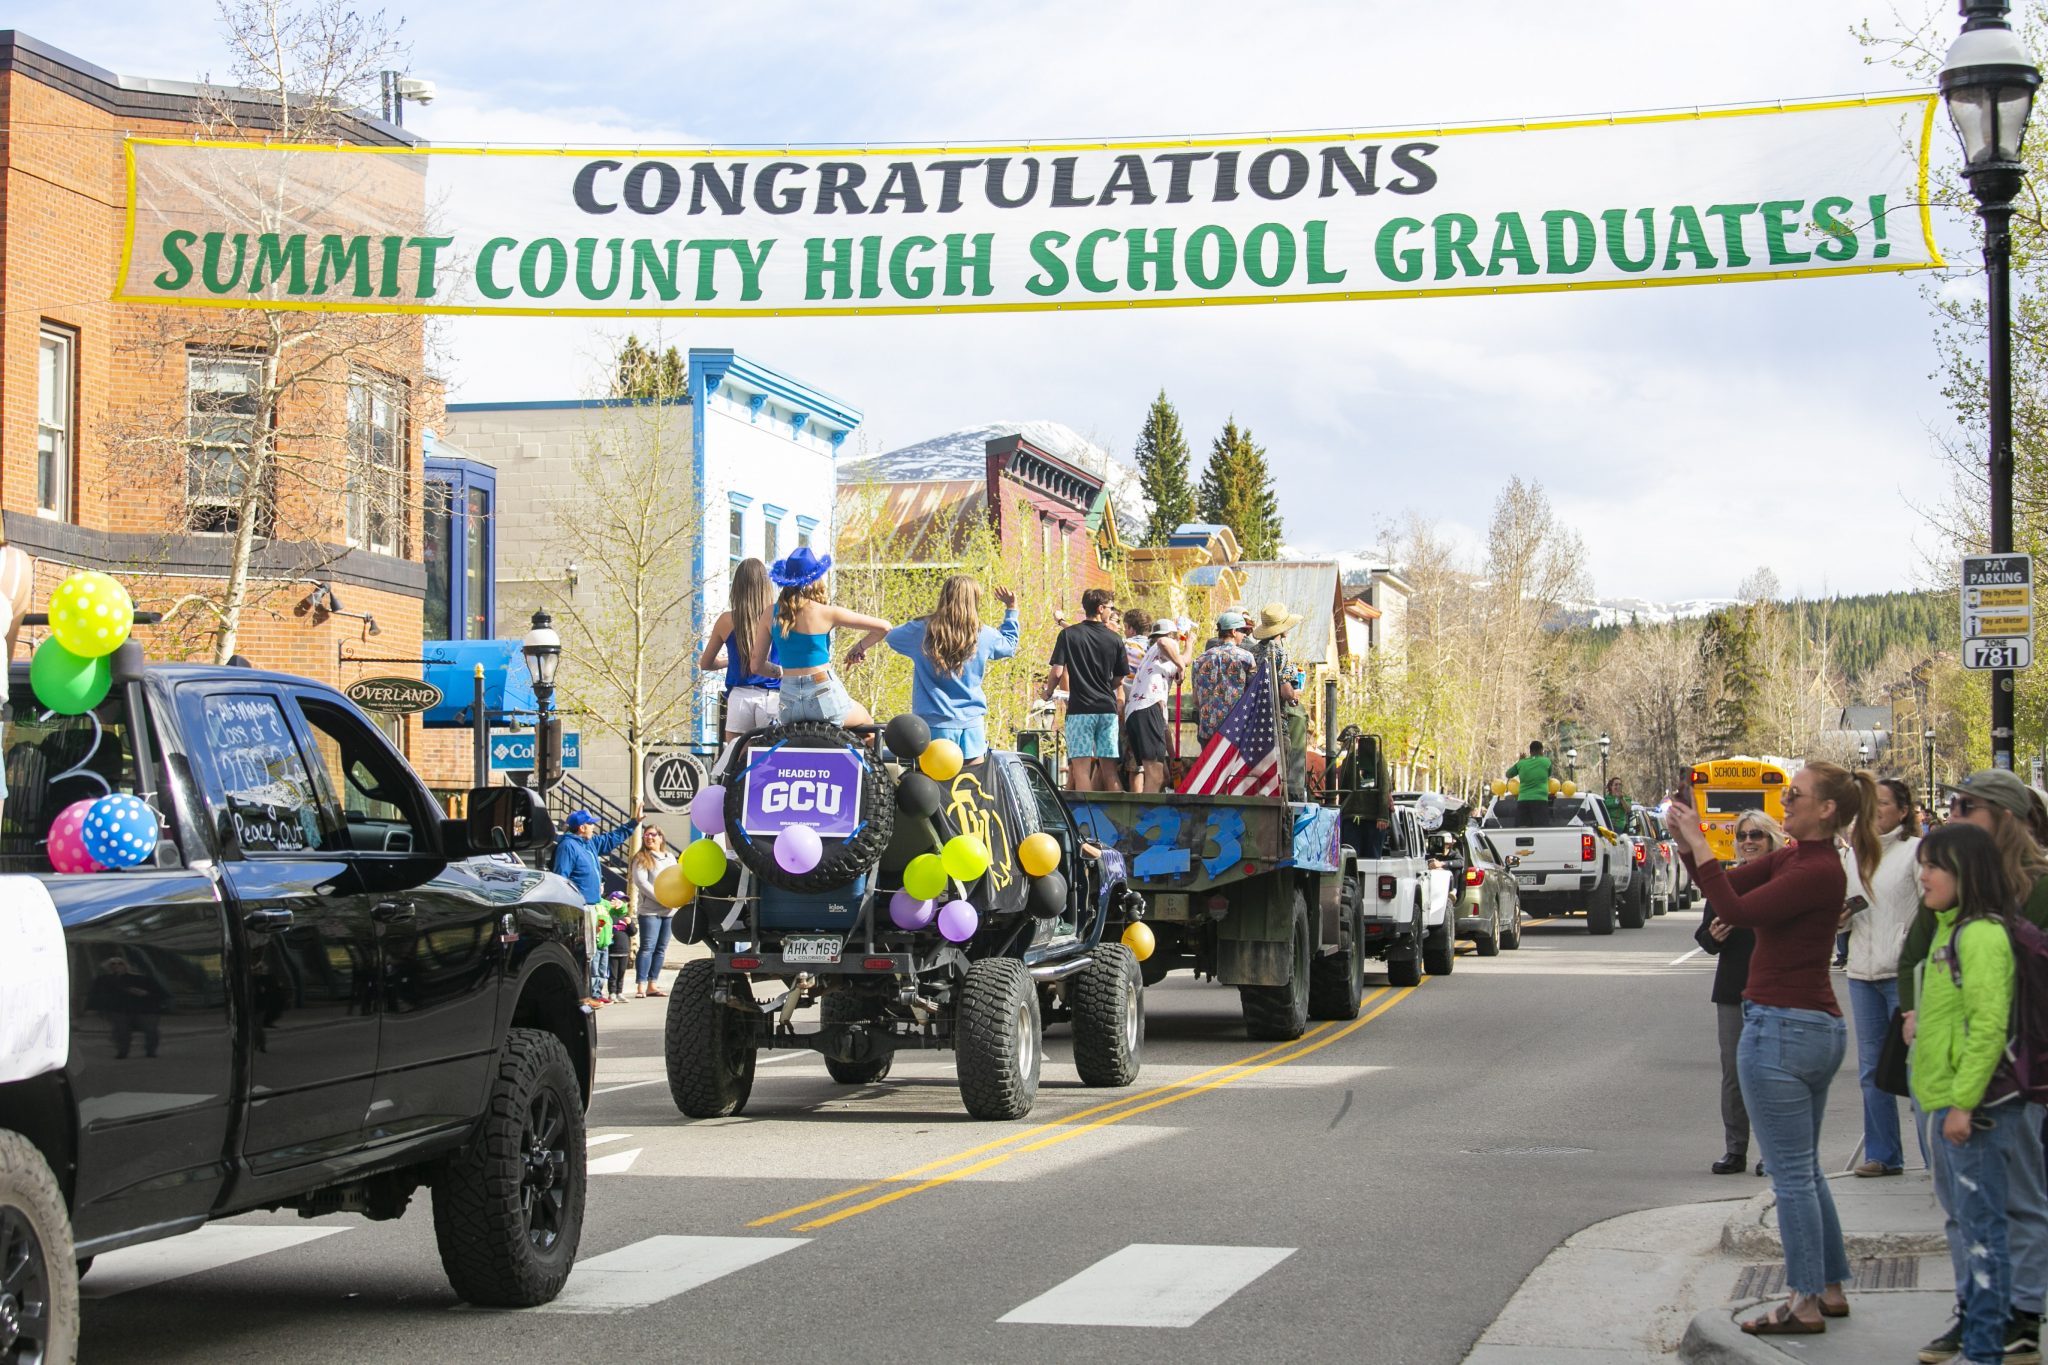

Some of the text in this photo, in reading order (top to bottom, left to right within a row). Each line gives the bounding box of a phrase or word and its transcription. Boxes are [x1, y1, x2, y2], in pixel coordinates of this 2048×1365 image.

[572, 142, 1440, 216] CONGRATULATIONS
[153, 193, 1888, 302] SUMMIT COUNTY HIGH SCHOOL GRADUATES!
[1984, 560, 2008, 572] PAY
[1970, 571, 2023, 584] PARKING
[1984, 639, 2008, 648] ZONE
[1977, 648, 2015, 667] 781
[351, 684, 435, 703] OVERLAND
[207, 710, 249, 748] Class
[509, 743, 577, 759] Colia
[660, 753, 673, 762] BIKE
[778, 768, 831, 779] HEADED TO
[1714, 766, 1756, 778] SCHOOL BUS
[659, 790, 694, 799] SLOPE STYLE
[761, 780, 843, 815] GCU
[234, 812, 275, 844] Peace
[828, 903, 844, 911] igloo
